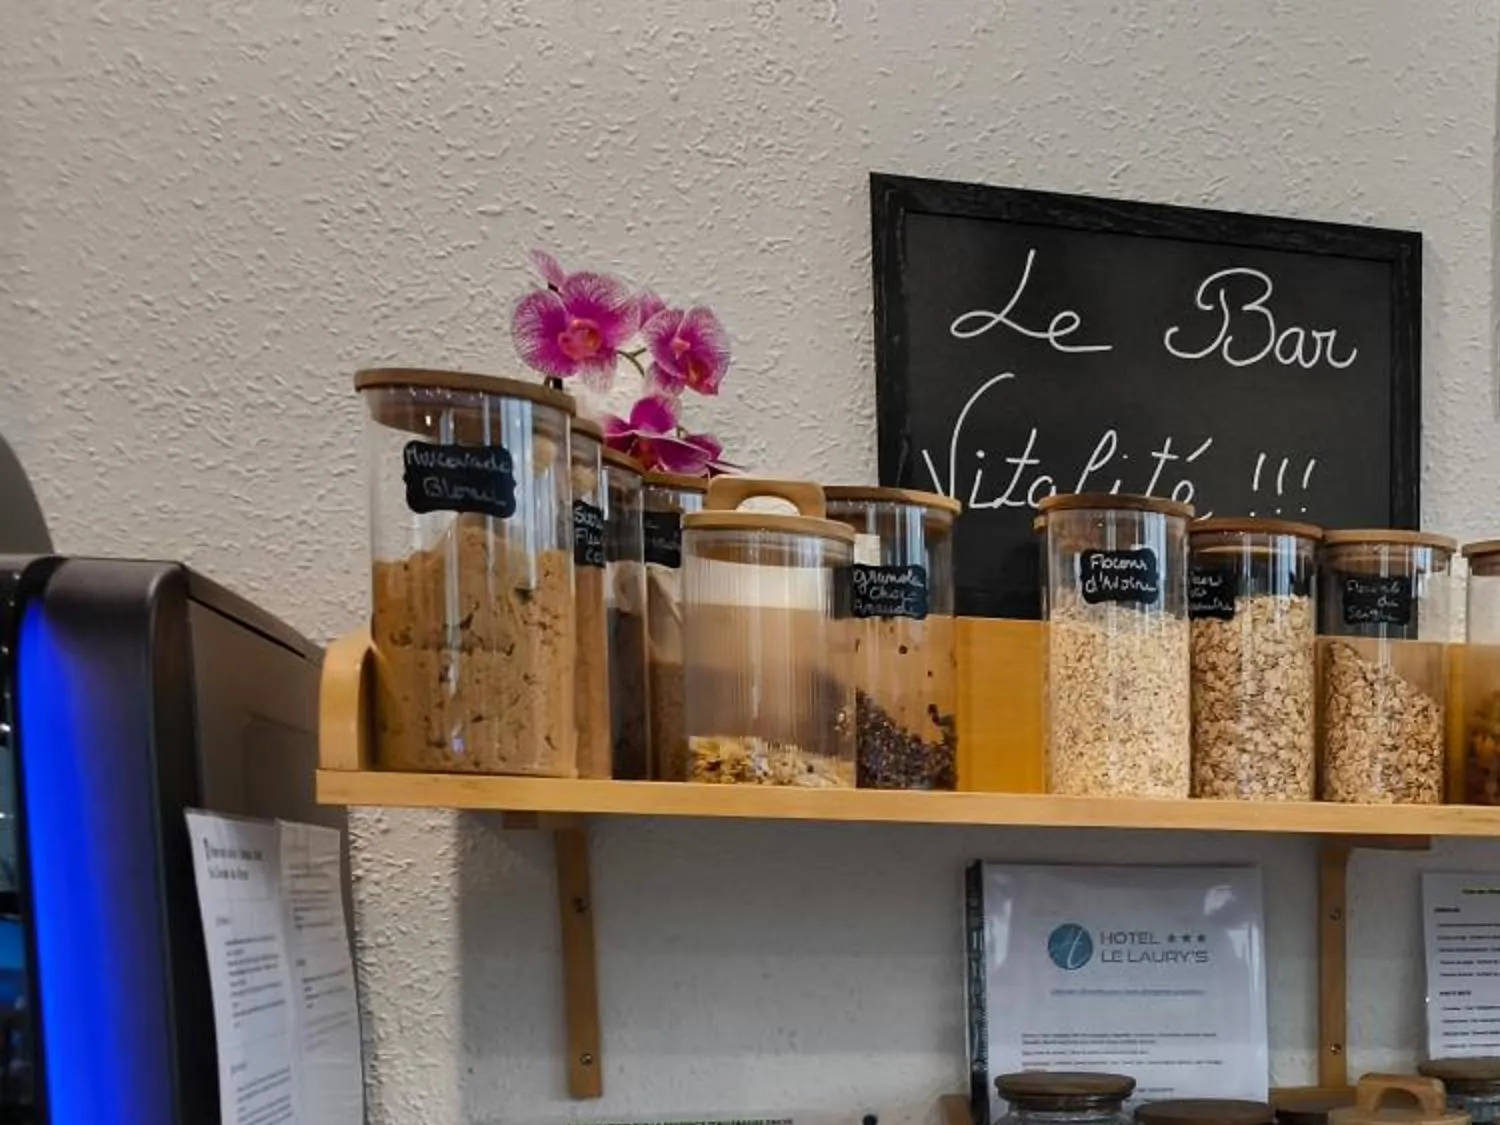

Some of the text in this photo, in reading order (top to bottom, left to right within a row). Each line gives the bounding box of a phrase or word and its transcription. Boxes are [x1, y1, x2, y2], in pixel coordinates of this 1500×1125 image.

[950, 248, 1358, 368] Le Bar
[1099, 930, 1161, 946] HOTEL
[1100, 949, 1209, 964] LE LAURY'S
